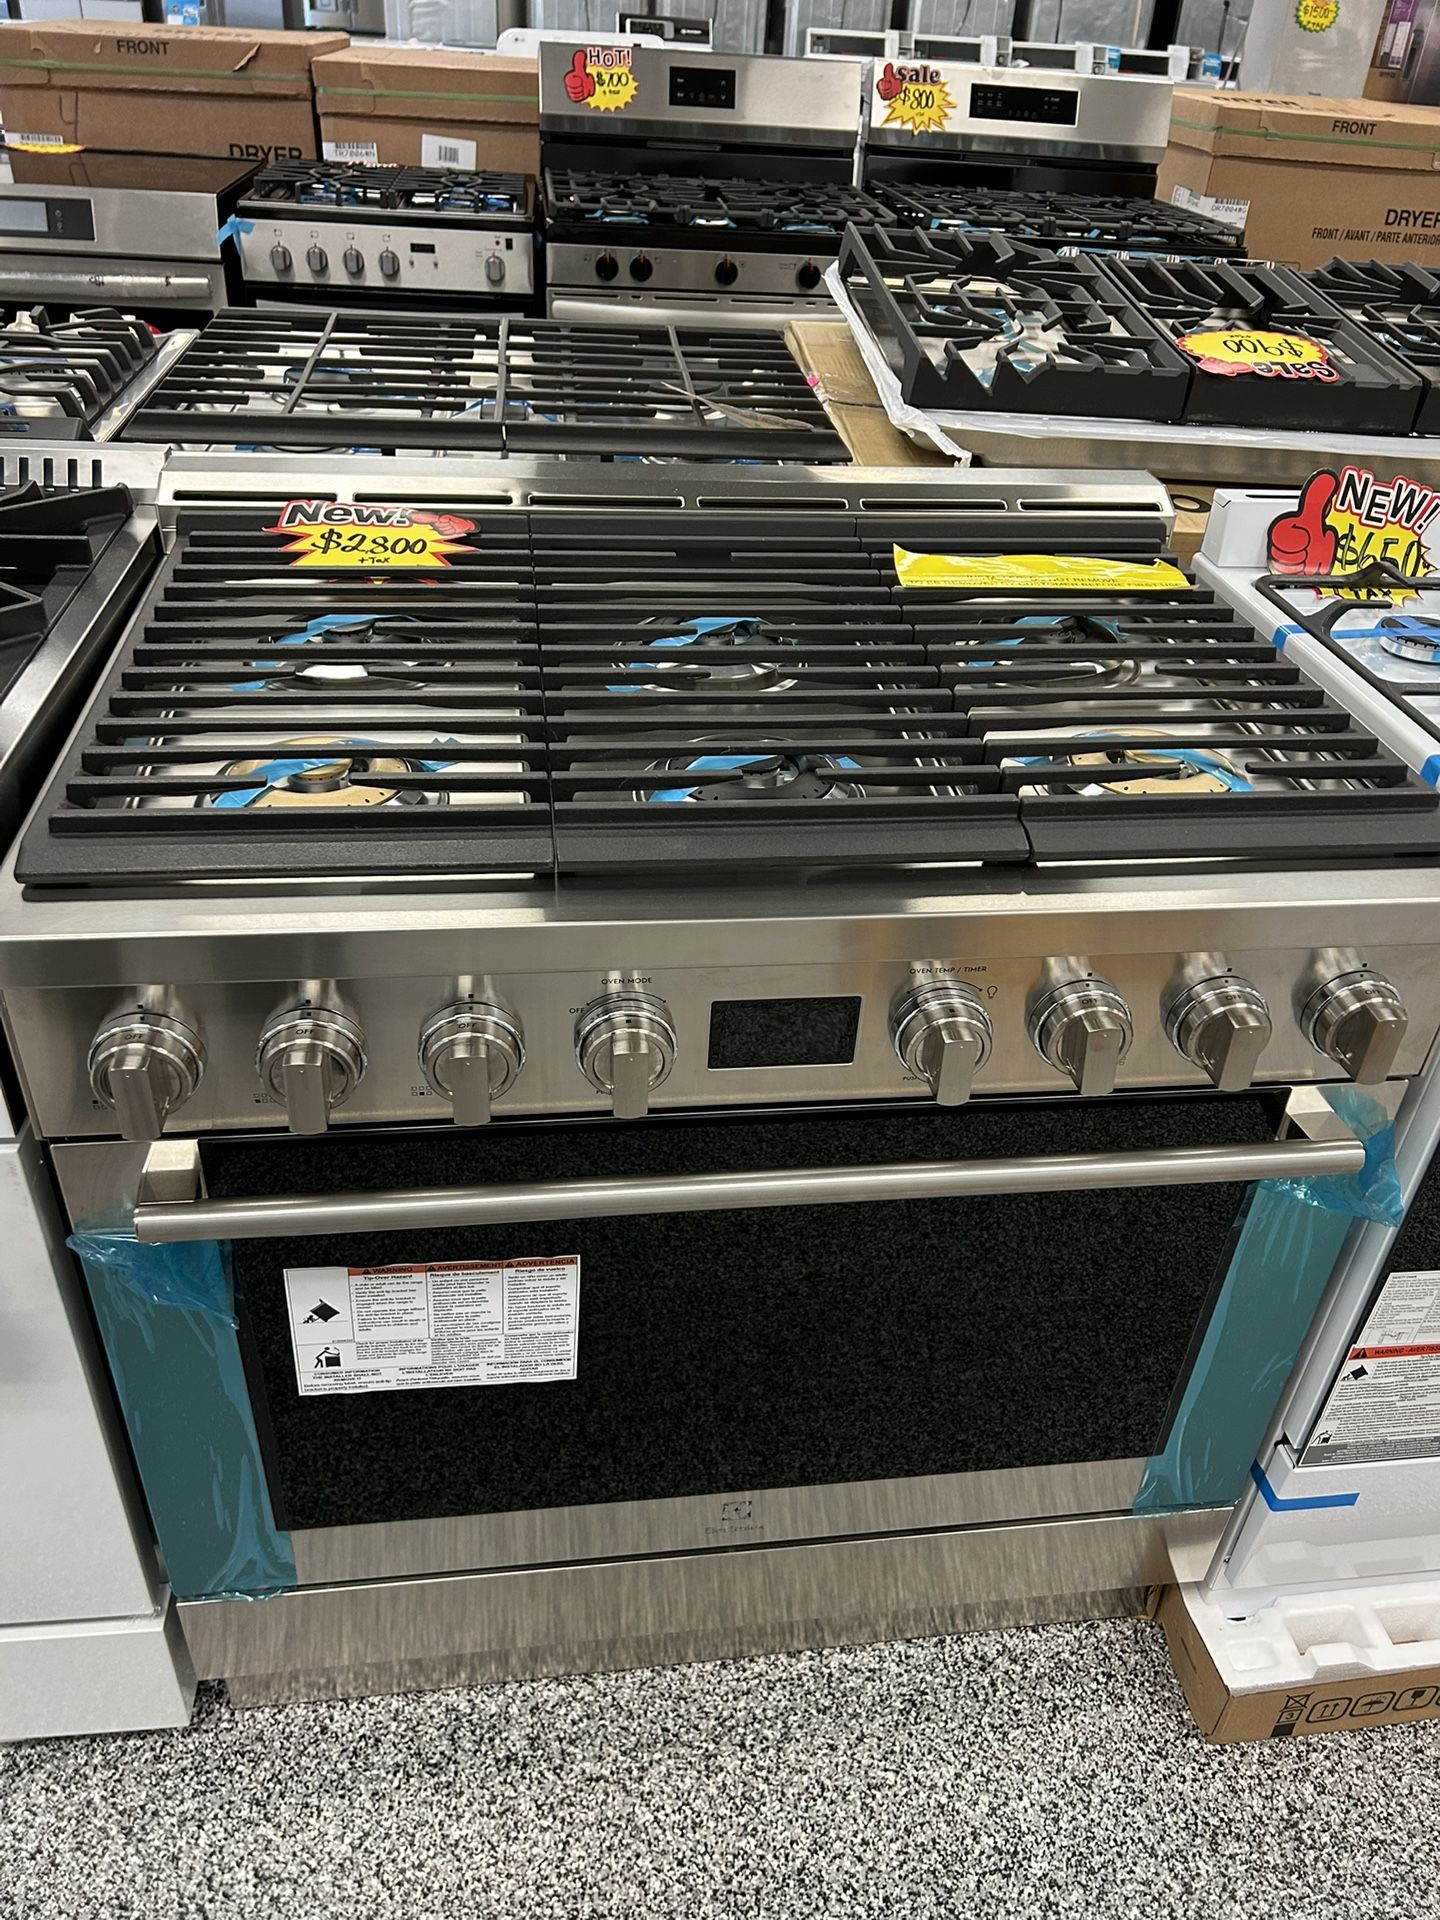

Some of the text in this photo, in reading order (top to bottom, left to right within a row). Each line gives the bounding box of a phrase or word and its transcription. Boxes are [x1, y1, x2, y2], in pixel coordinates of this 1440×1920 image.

[117, 39, 169, 55] FRONT
[588, 48, 632, 68] HOT!
[596, 70, 629, 87] $700
[899, 85, 935, 110] $800
[1332, 120, 1377, 136] FRONT
[1312, 227, 1339, 241] FRONT
[1344, 229, 1370, 243] AVANT
[1376, 231, 1402, 244] PARTE
[1222, 338, 1304, 358] $900
[1337, 471, 1440, 532] NEW!
[285, 503, 408, 525] New!
[311, 528, 428, 555] $2,800
[1335, 523, 1423, 578] $650
[934, 967, 955, 975] TEMP
[963, 965, 987, 973] TIMER
[295, 1028, 315, 1036] OFF
[458, 1022, 477, 1030] OFF
[124, 1033, 145, 1041] OFF
[437, 1263, 502, 1271] AVERTISSEMENT
[516, 1259, 575, 1268] ADVERTENCIA
